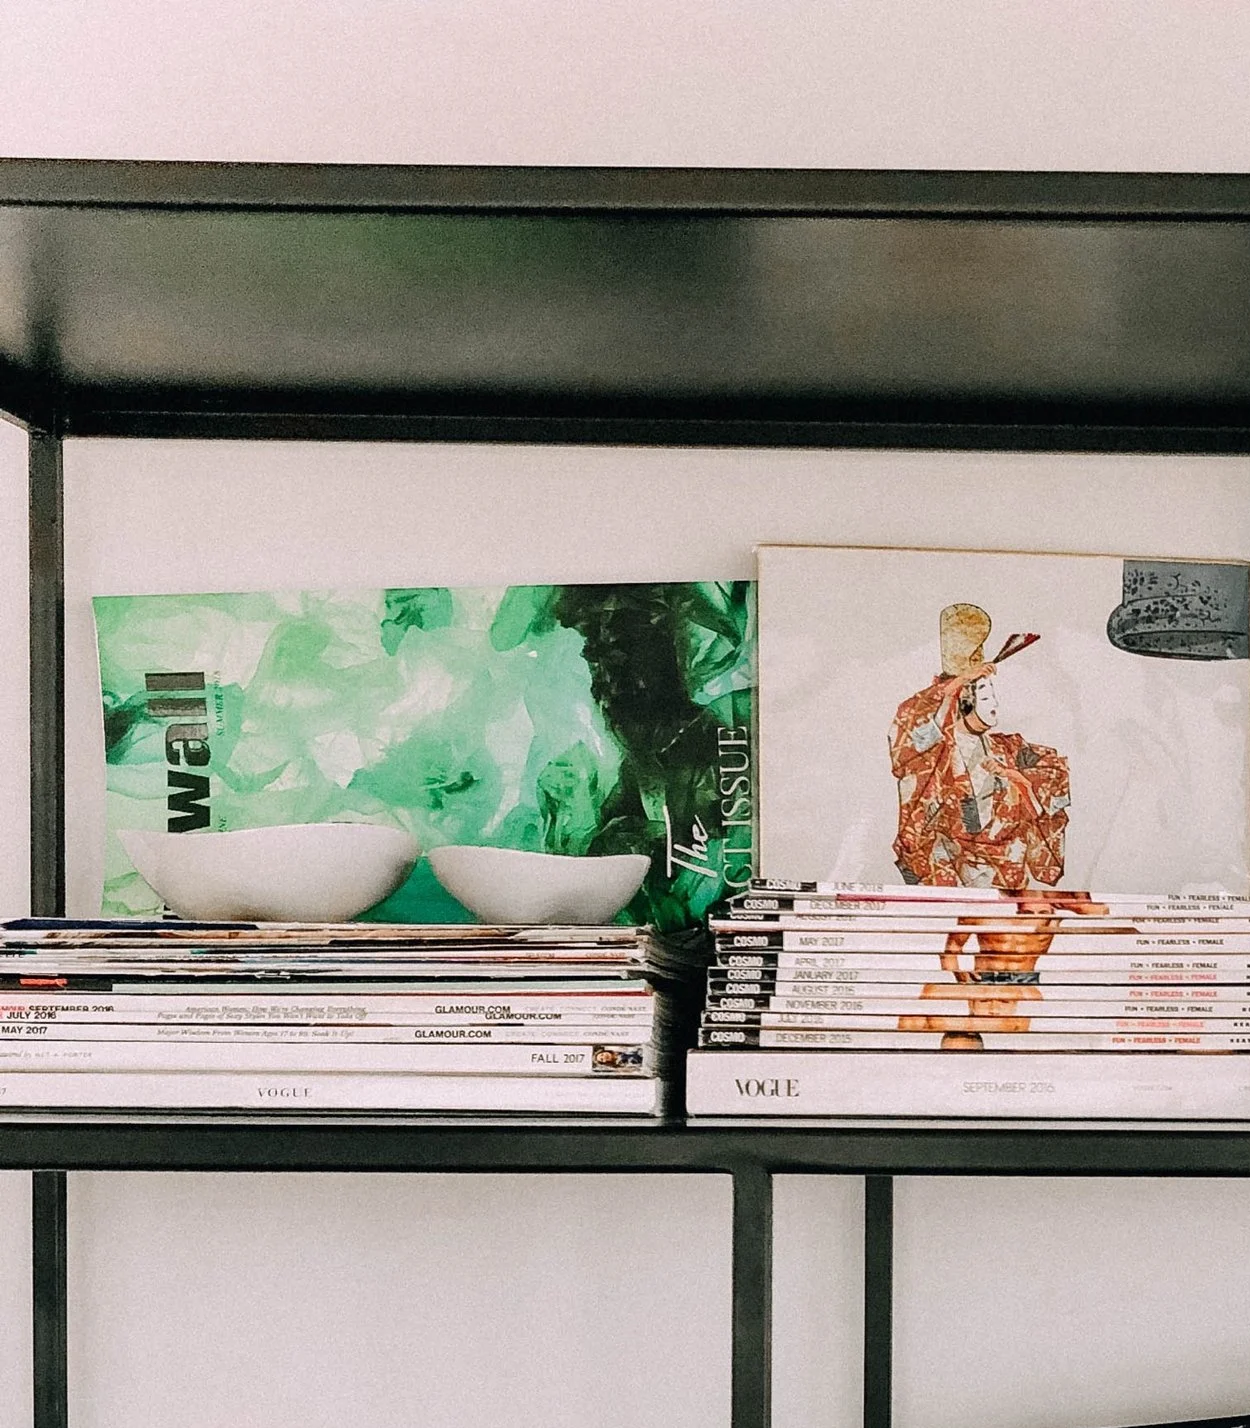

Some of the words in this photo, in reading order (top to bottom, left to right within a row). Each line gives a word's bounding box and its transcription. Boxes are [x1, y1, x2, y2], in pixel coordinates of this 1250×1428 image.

[716, 726, 753, 827] ISSUE
[662, 805, 719, 878] The
[733, 936, 769, 948] COSMO
[720, 997, 756, 1009] COSMO
[434, 1004, 511, 1015] GLAMOUR.COM
[1, 1025, 23, 1036] MAY
[26, 1026, 48, 1036] 2017
[414, 1029, 492, 1040] GLAMOUR.COM
[530, 1053, 559, 1064] FALL
[563, 1053, 585, 1064] 2017
[258, 1087, 313, 1099] VOGUE
